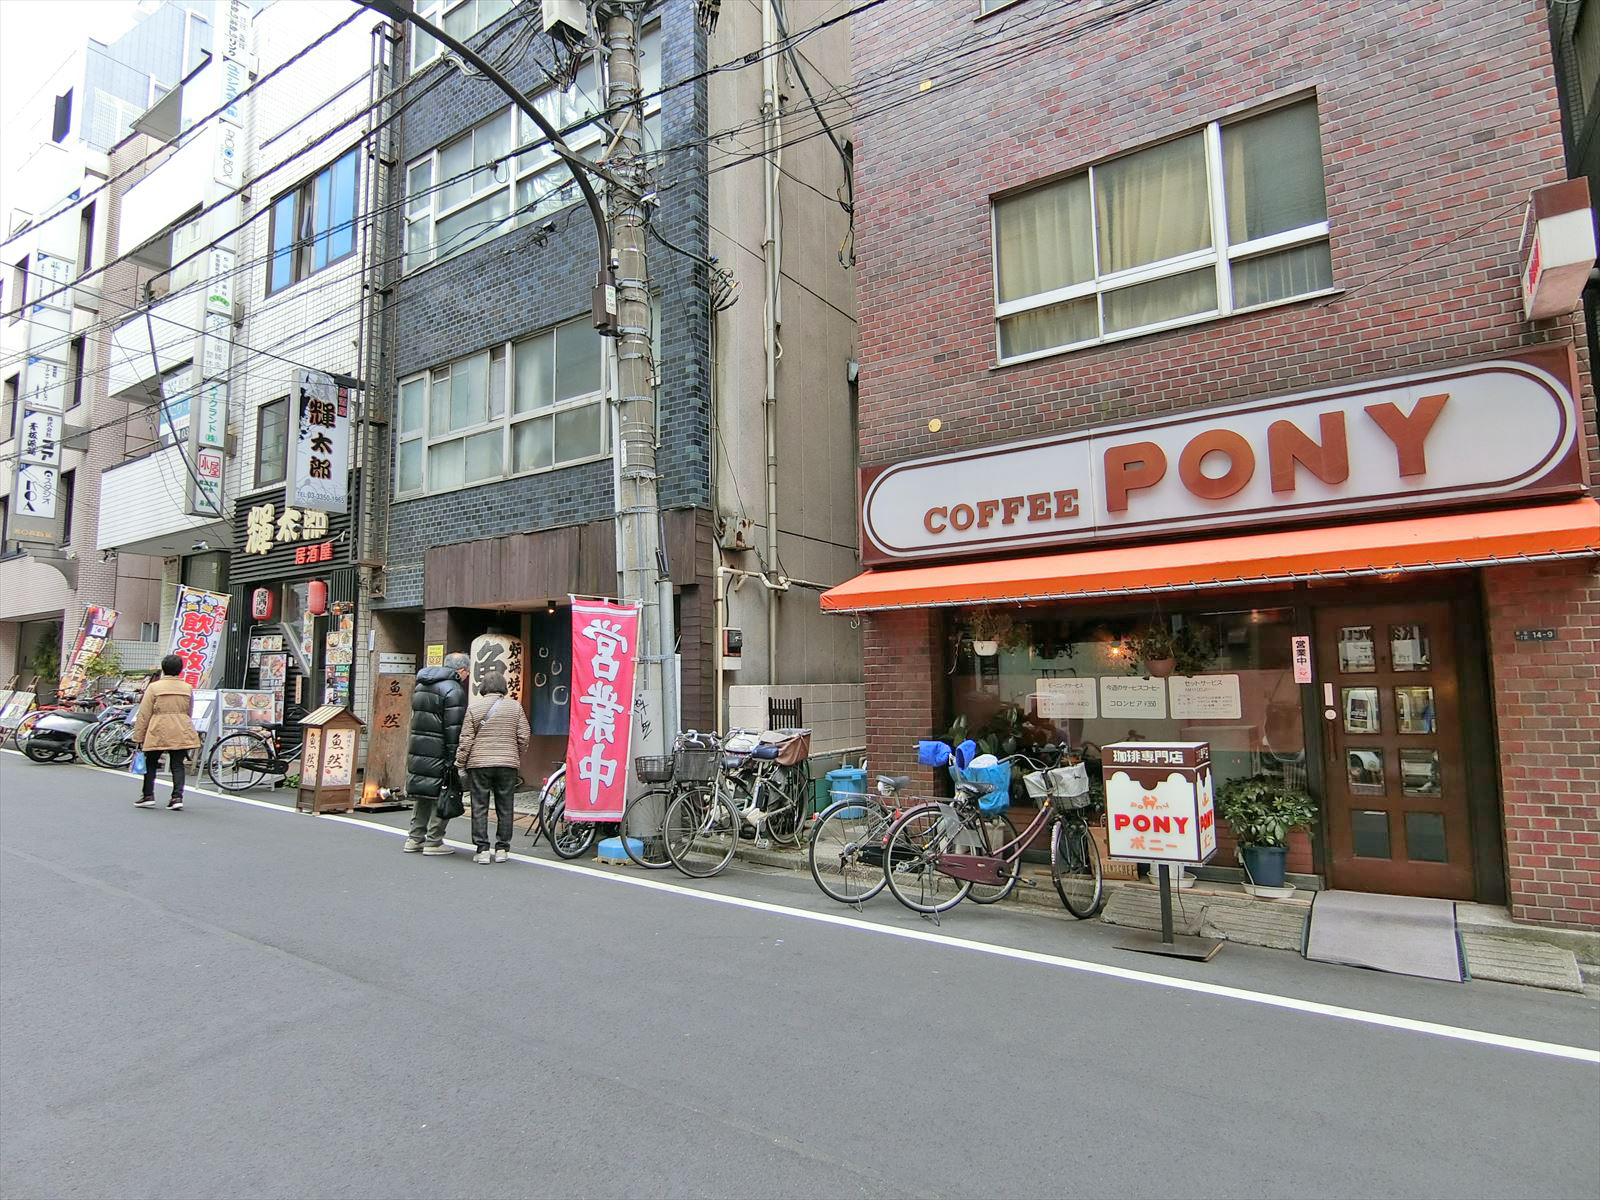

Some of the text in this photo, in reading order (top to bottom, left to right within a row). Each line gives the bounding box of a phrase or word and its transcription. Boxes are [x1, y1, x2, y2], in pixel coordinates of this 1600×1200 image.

[308, 399, 336, 480] 輝太郎
[923, 392, 1450, 533] COFFEE PONY
[245, 503, 330, 555] 輝太郎
[295, 542, 334, 565] 居酒屋
[1532, 630, 1553, 639] 14-9
[1296, 640, 1307, 665] 営業中
[579, 619, 628, 804] 営業中
[325, 733, 344, 770] 魚然
[1112, 750, 1184, 764] 珈琲専門店
[1114, 813, 1189, 835] PONY
[1129, 835, 1178, 851] ポニー
